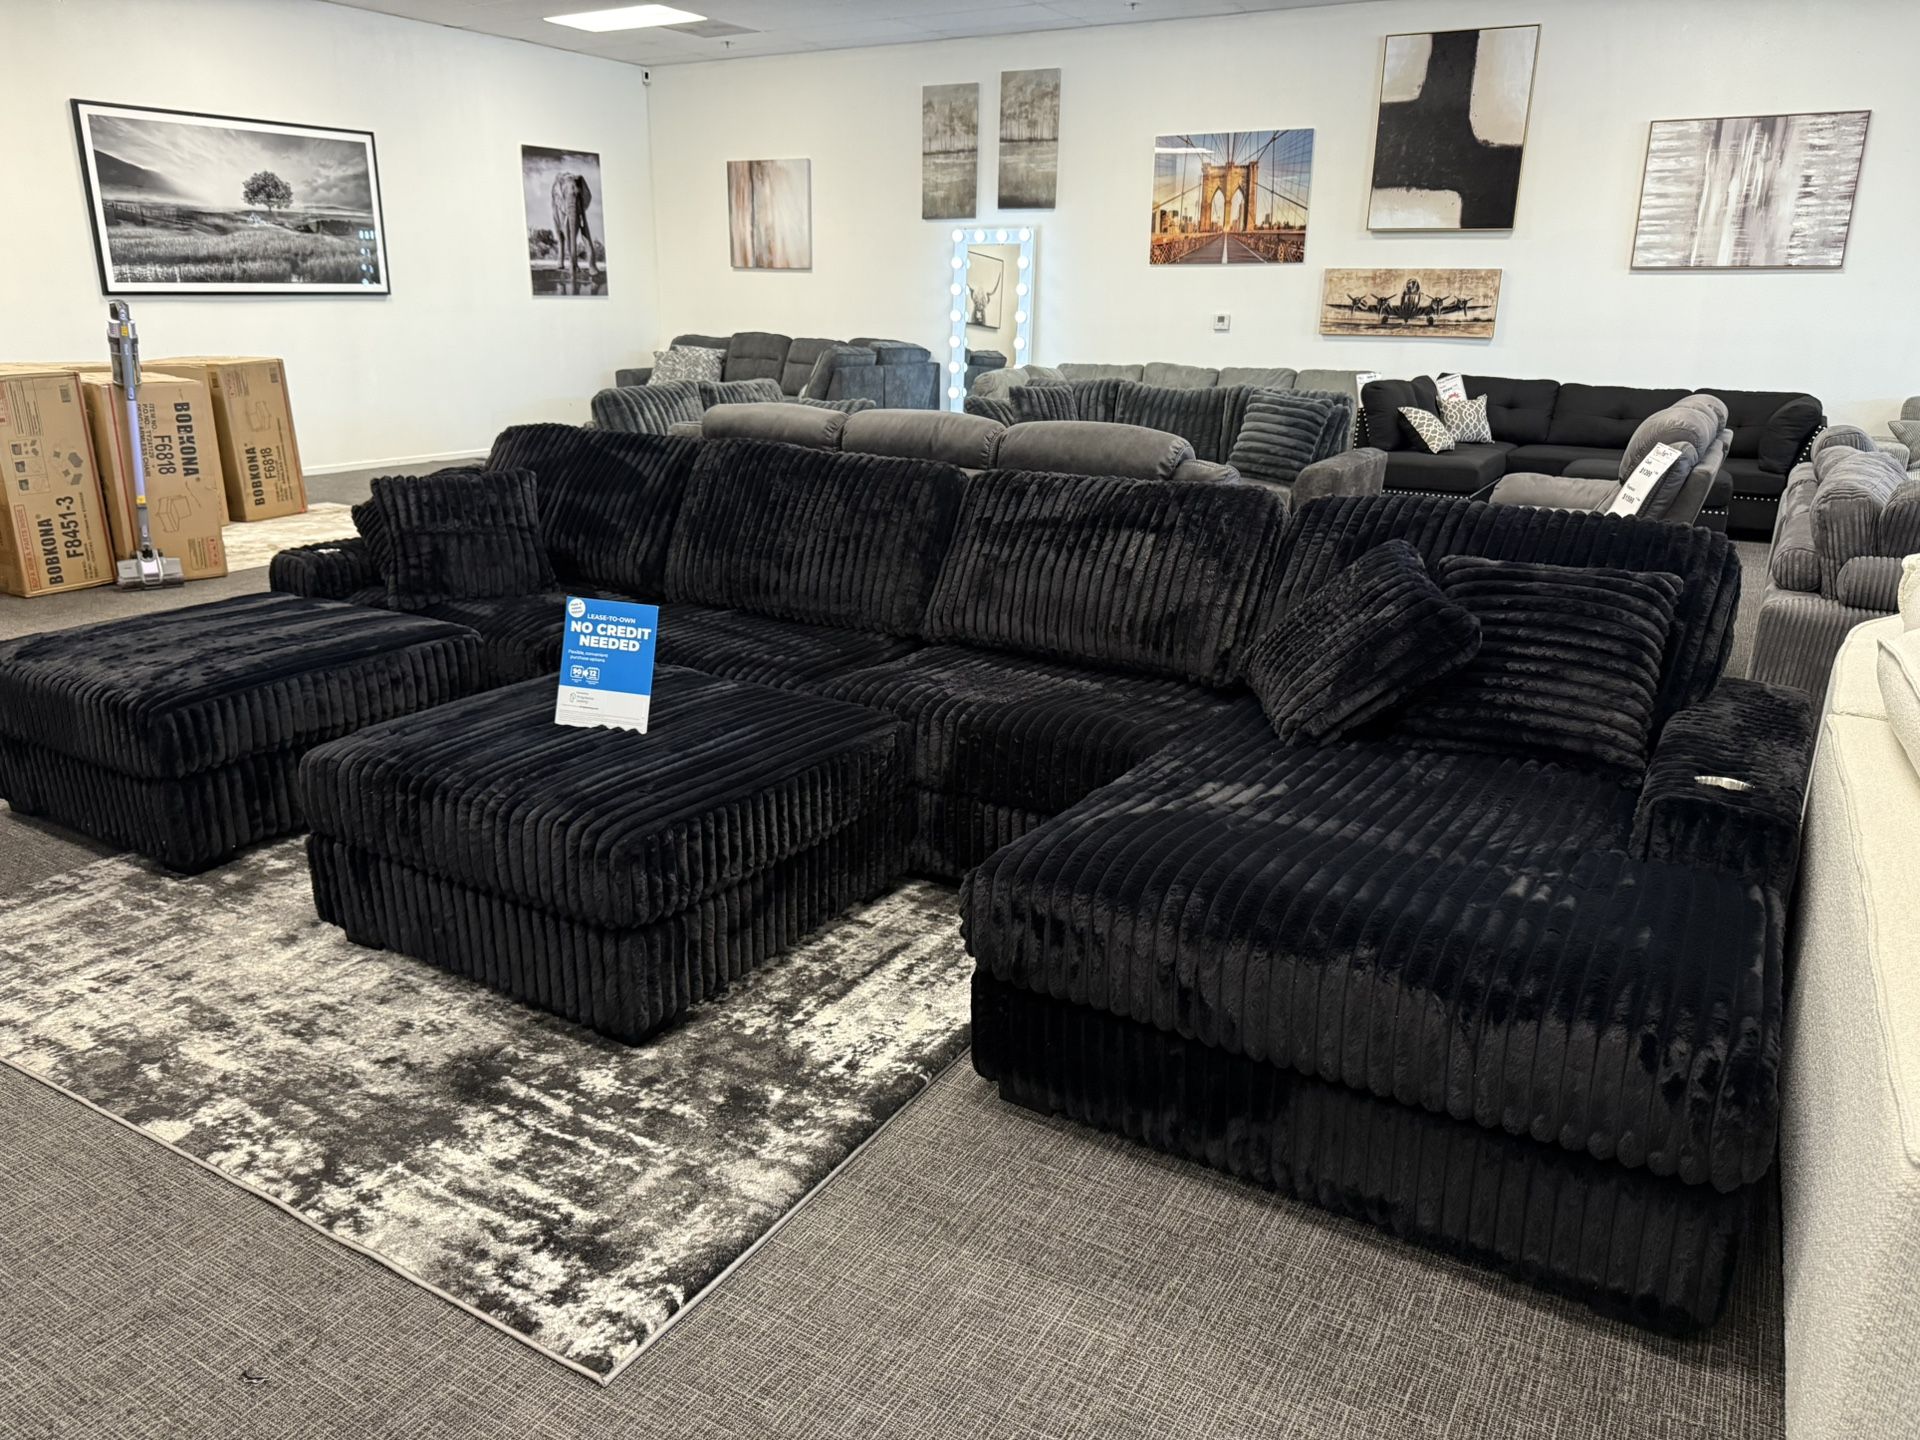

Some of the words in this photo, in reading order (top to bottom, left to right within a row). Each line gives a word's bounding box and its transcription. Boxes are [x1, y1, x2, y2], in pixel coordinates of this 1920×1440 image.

[153, 435, 176, 475] F6818
[173, 402, 200, 477] BOBKONA
[245, 446, 266, 506] BOBKONA
[260, 447, 277, 480] F6818
[56, 495, 84, 559] F8451-3
[37, 518, 64, 586] BOBKONA
[570, 620, 594, 634] NO
[596, 623, 652, 640] CREDIT
[587, 613, 636, 624] LEASE-TO-OWN
[579, 635, 641, 652] NEEDED
